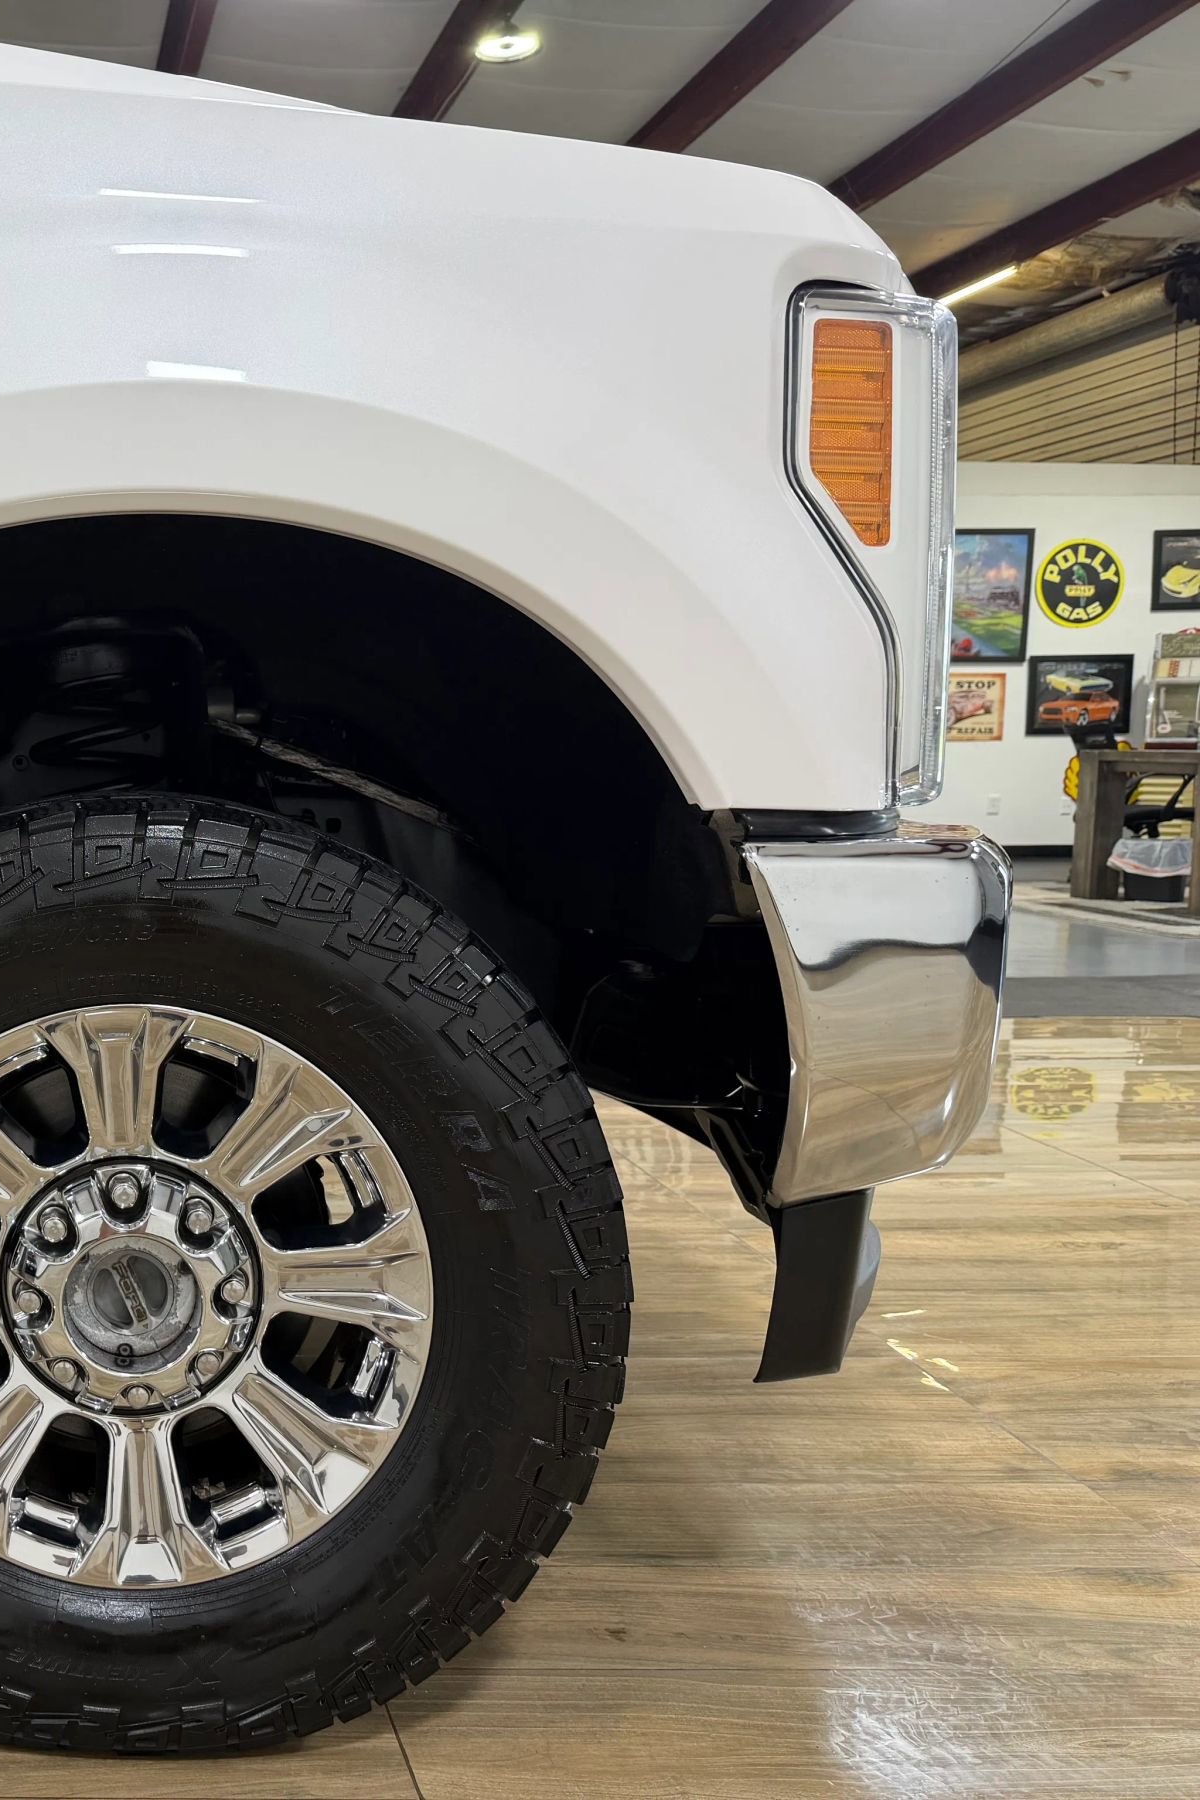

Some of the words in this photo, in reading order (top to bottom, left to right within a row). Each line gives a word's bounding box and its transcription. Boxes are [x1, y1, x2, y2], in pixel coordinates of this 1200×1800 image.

[1044, 545, 1119, 584] POLLY
[1055, 601, 1103, 621] GAS
[955, 680, 997, 689] STOP
[112, 1261, 148, 1323] FORD
